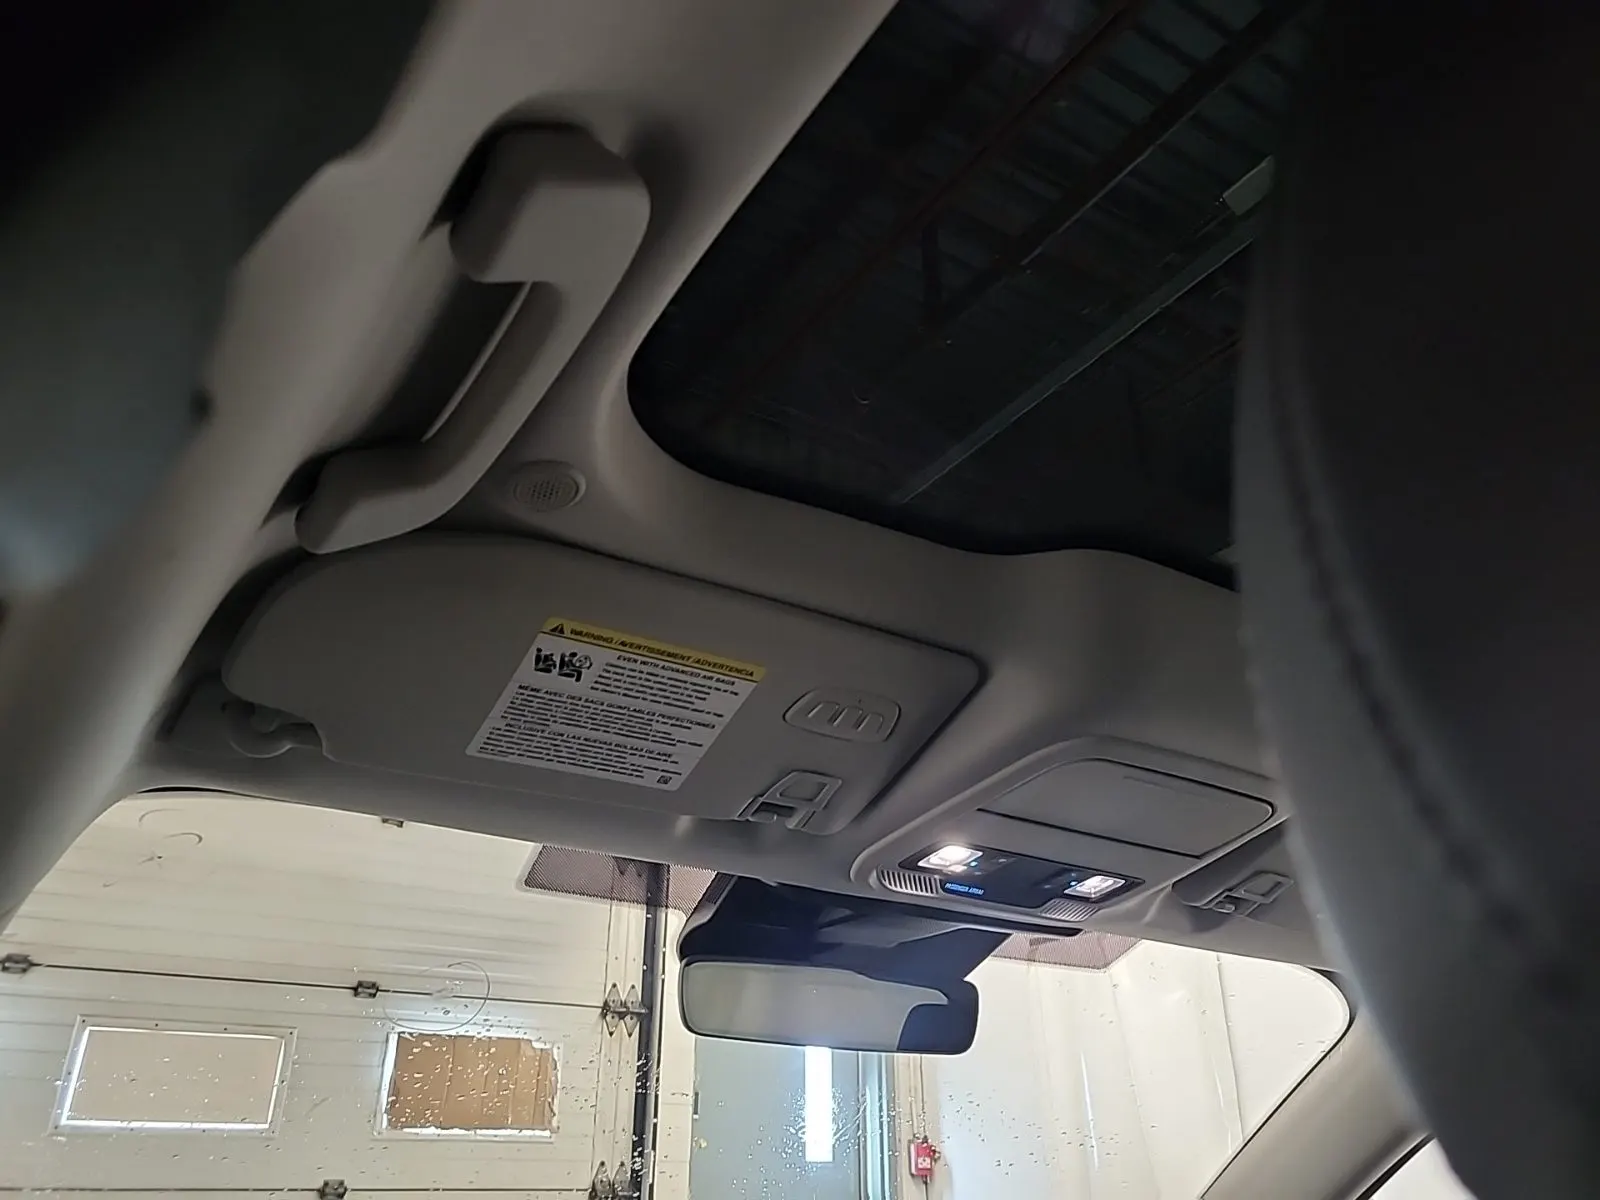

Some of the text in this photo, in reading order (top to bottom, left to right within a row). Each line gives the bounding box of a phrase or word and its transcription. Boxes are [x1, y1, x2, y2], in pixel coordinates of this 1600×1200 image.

[568, 628, 614, 643] WARNING
[616, 654, 640, 663] EVEN
[639, 659, 660, 668] WITH
[659, 664, 701, 677] ADVANCED
